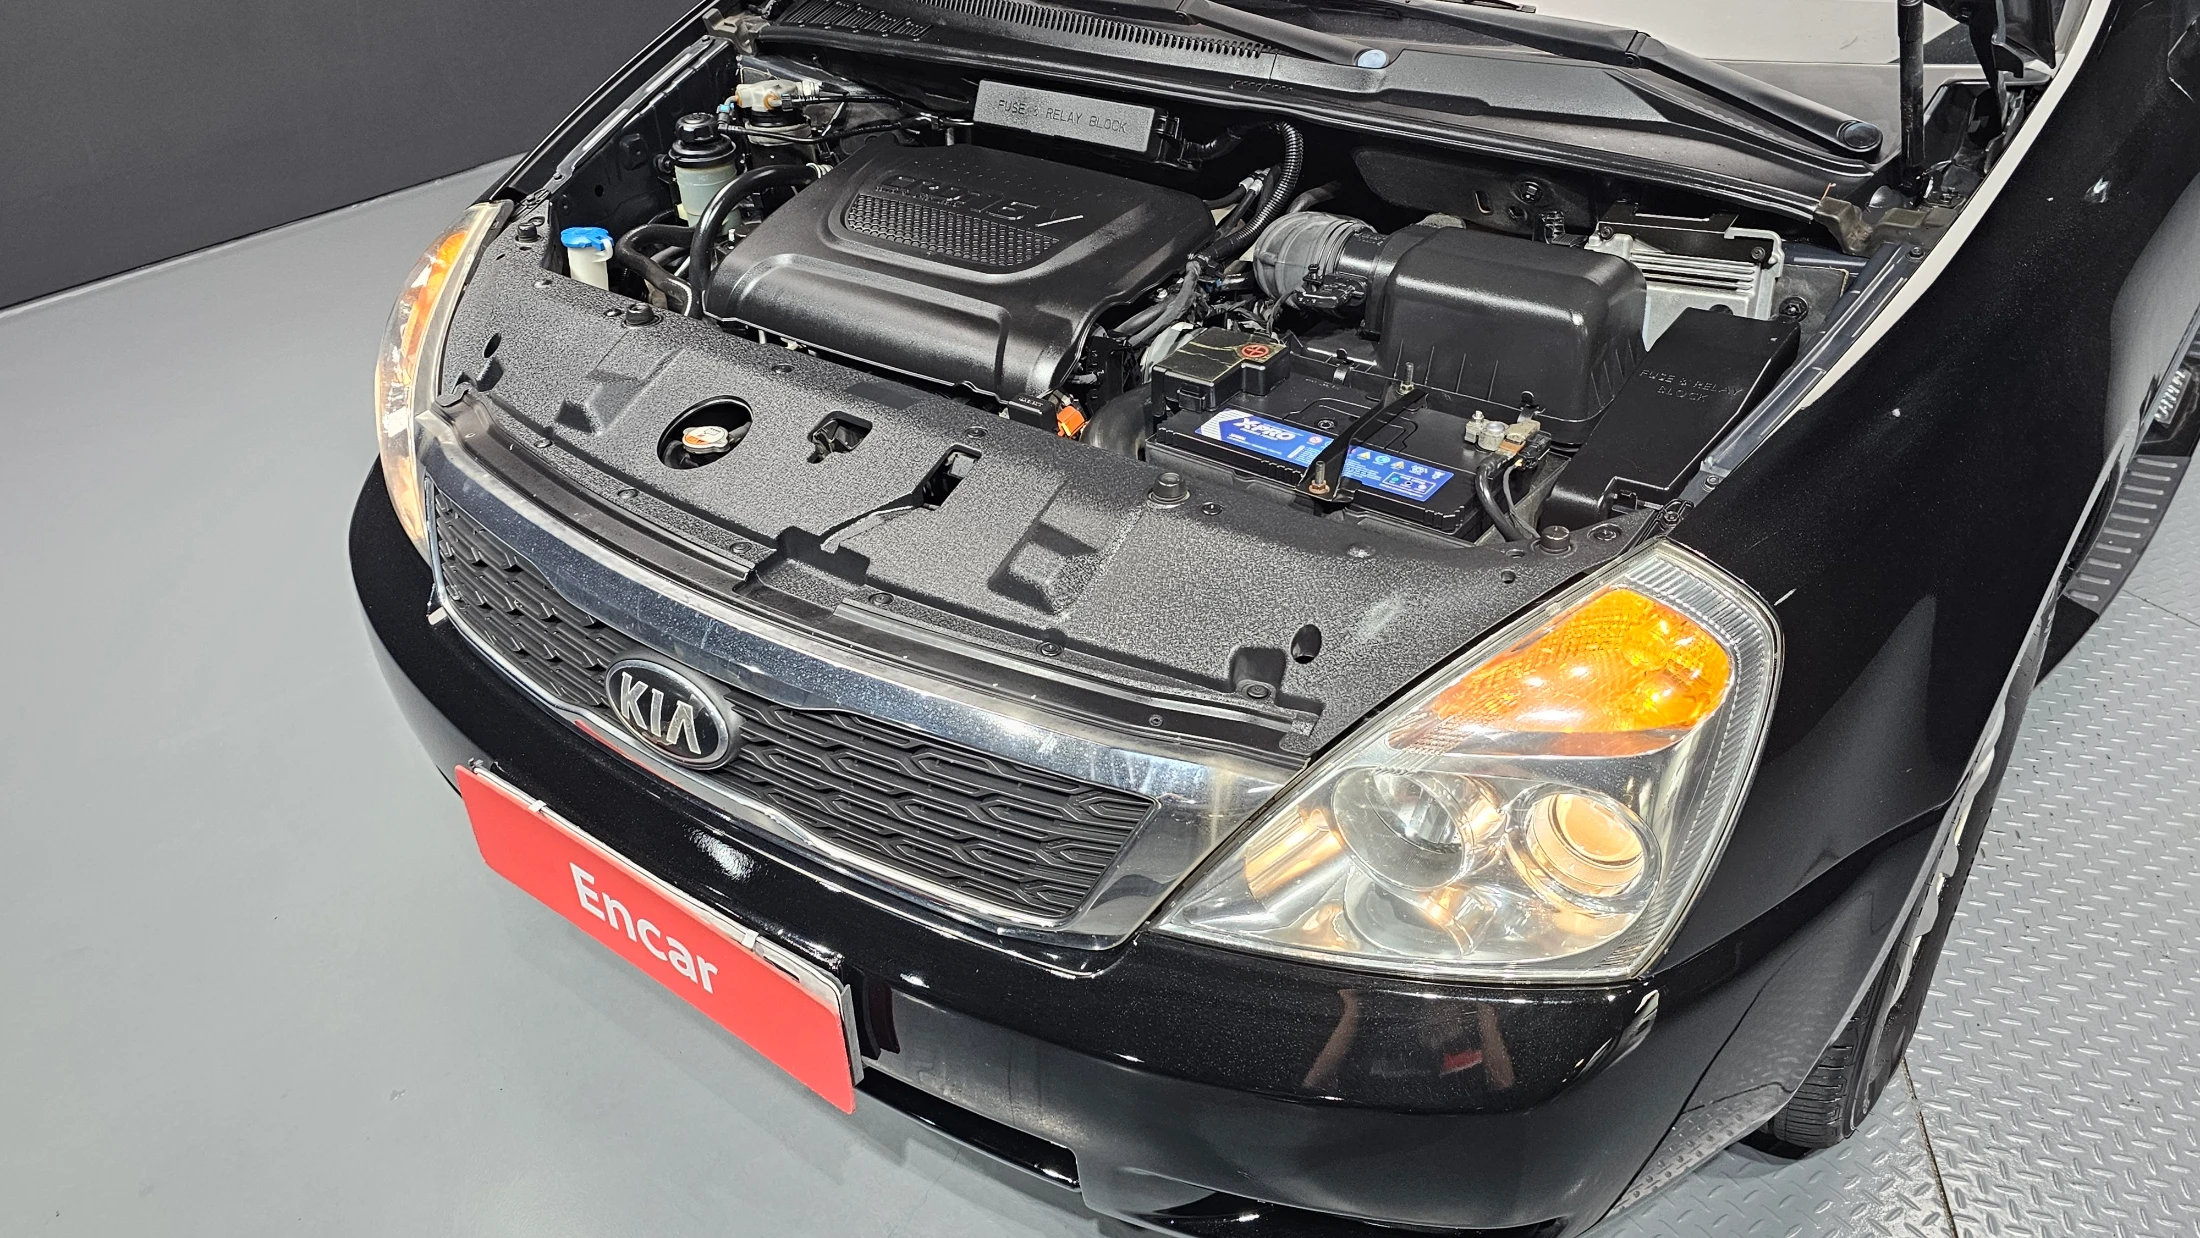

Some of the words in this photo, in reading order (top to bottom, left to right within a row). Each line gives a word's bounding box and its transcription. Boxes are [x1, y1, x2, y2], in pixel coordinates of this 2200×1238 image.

[998, 99, 1026, 116] FUSE
[1045, 107, 1083, 125] RELAY
[1088, 115, 1127, 133] BLOCK
[1640, 369, 1675, 383] FUSE
[621, 671, 701, 754] KIA
[569, 861, 718, 994] Encar
